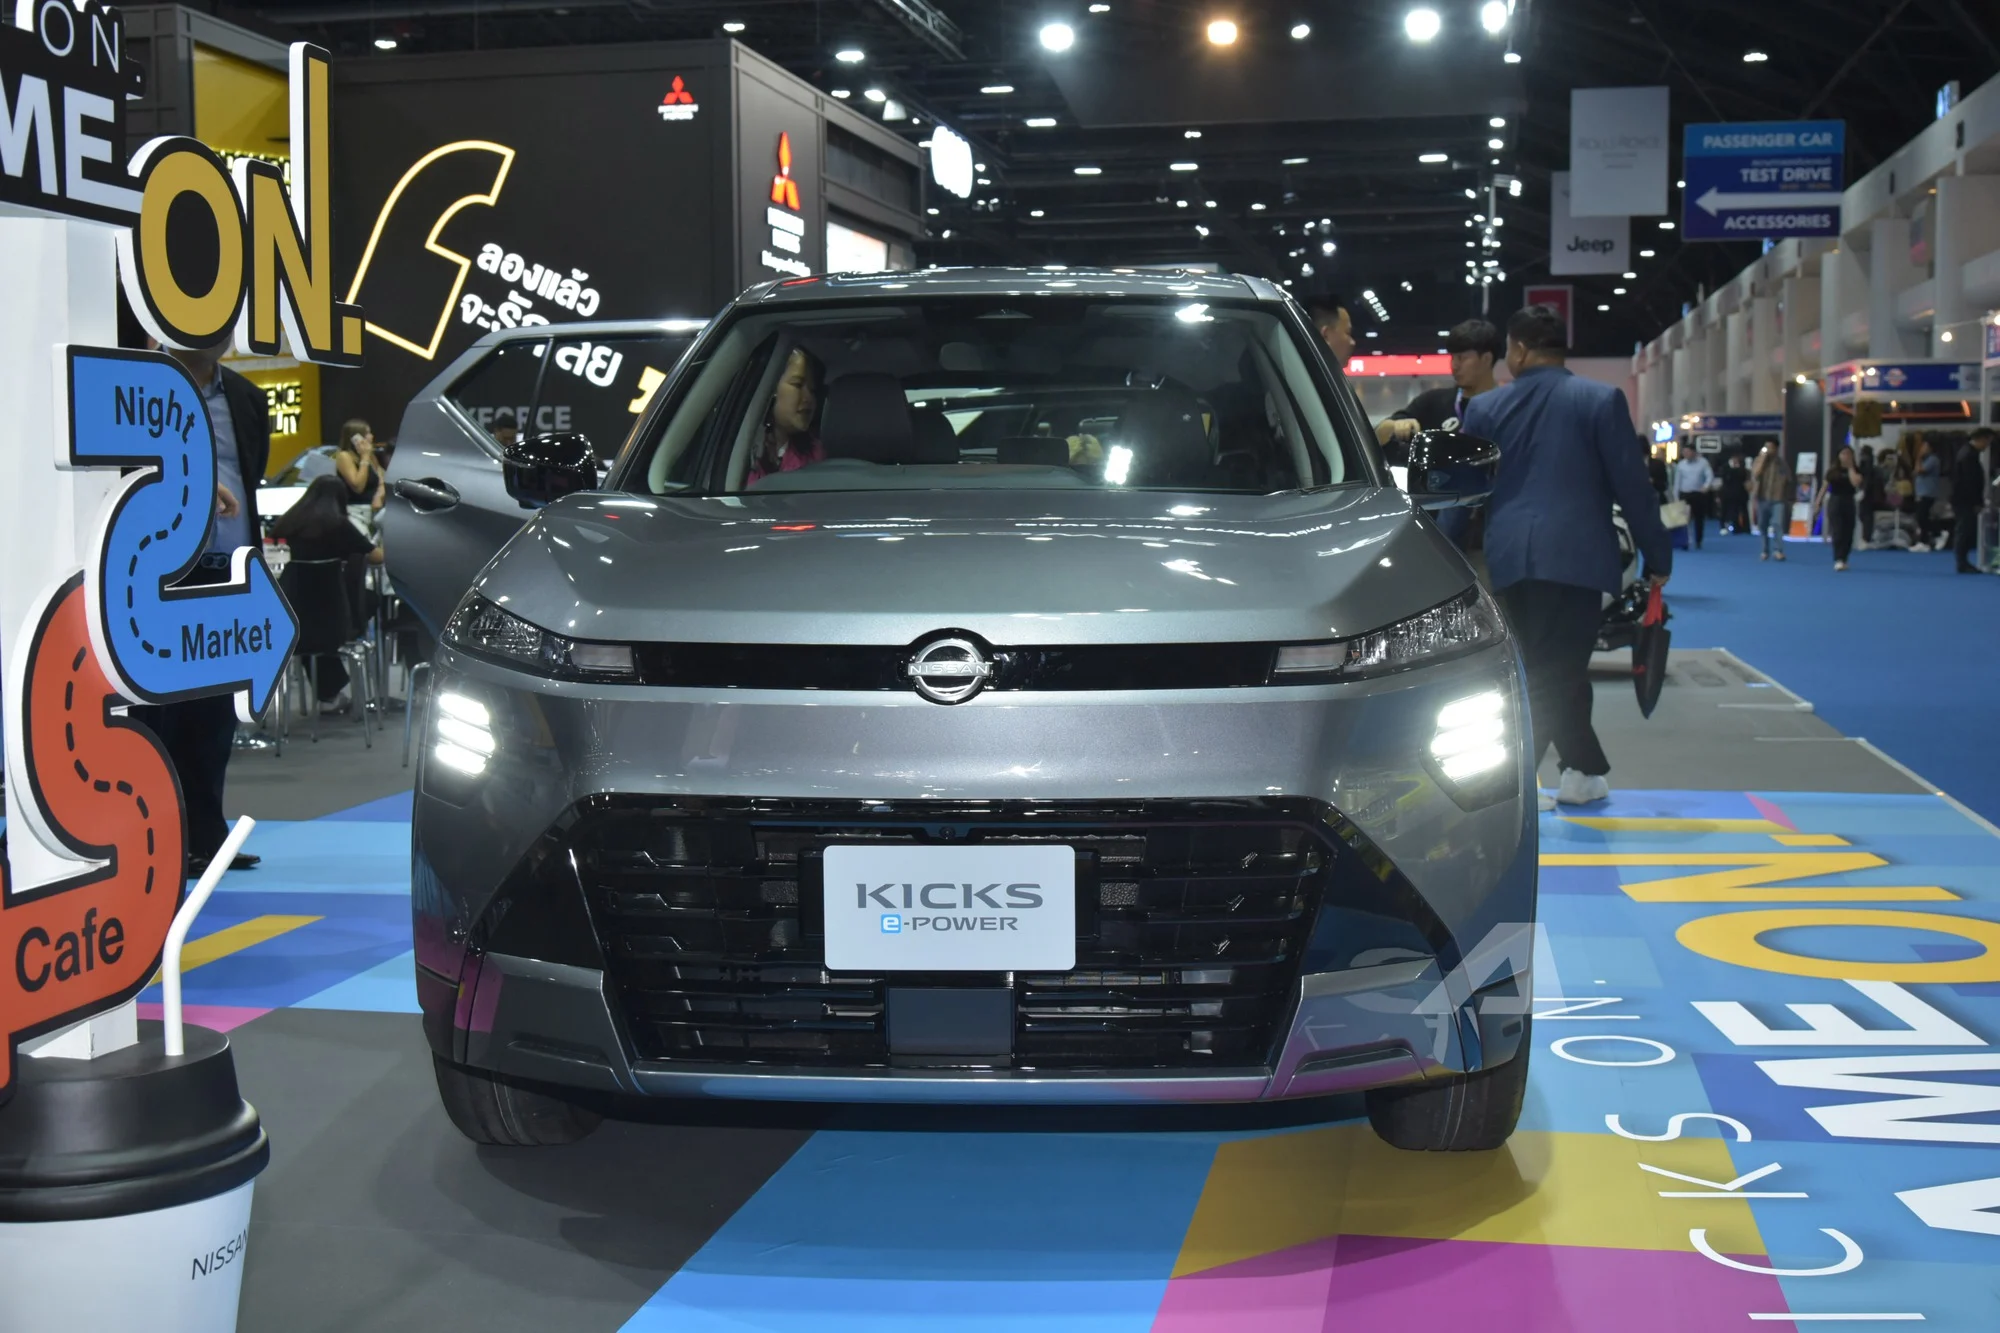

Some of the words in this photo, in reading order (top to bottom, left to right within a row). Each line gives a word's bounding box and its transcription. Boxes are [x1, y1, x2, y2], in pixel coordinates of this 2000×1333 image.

[1703, 133, 1796, 149] PASSENGER
[1799, 131, 1833, 147] CAR
[1740, 167, 1780, 183] TEST
[1782, 166, 1832, 182] DRIVE
[1723, 213, 1832, 230] ACCESSORIES
[1566, 235, 1615, 254] Jeep
[476, 243, 600, 317] ลองแล้ว
[114, 385, 196, 443] Night
[181, 617, 272, 662] Market
[909, 663, 989, 675] NISSAN
[855, 882, 1044, 910] KICKS
[881, 914, 1019, 933] e-POWER
[15, 907, 125, 993] Cafe
